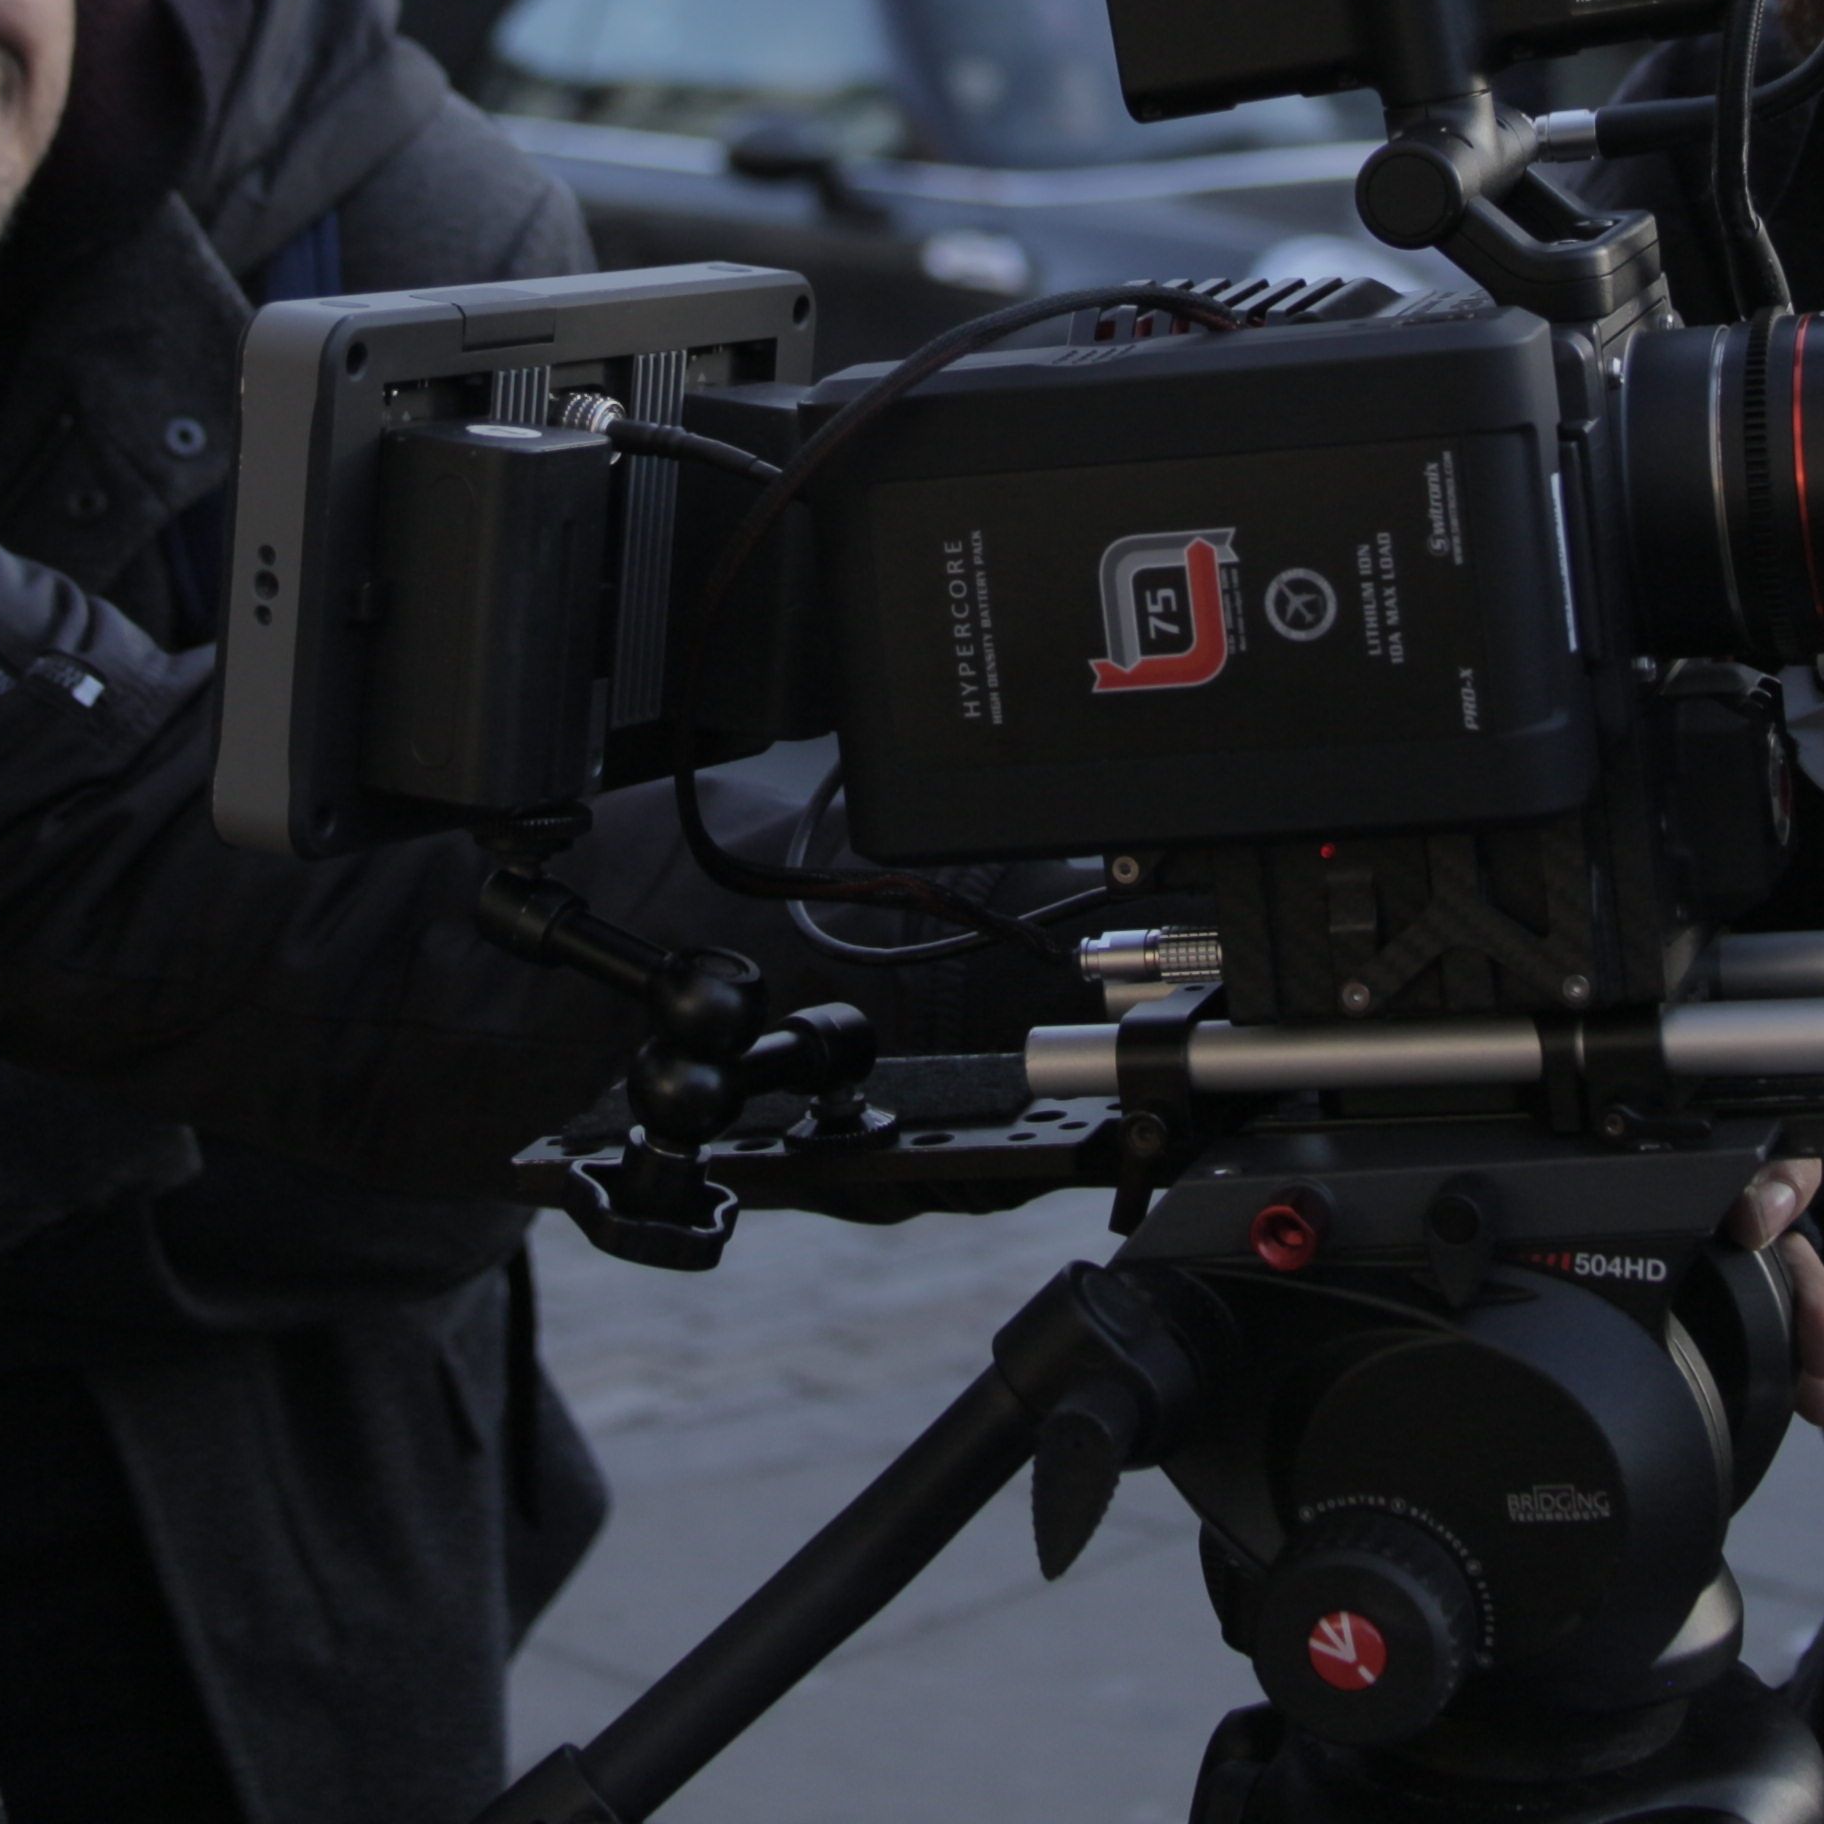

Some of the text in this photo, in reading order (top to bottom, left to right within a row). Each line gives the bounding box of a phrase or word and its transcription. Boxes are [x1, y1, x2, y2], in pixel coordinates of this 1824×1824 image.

[1424, 461, 1451, 556] Switronix
[1376, 532, 1395, 581] LOAD
[970, 529, 1003, 725] HIGH DENSITY BATTERY PACK
[1145, 588, 1180, 640] 75
[1356, 543, 1383, 656] LITHIUM ION
[1382, 585, 1401, 626] MAX
[944, 540, 982, 719] HYPERCORE
[1457, 666, 1480, 731] PRO-X
[1573, 1251, 1668, 1283] 504HD
[1506, 1483, 1611, 1513] BRIDGING
